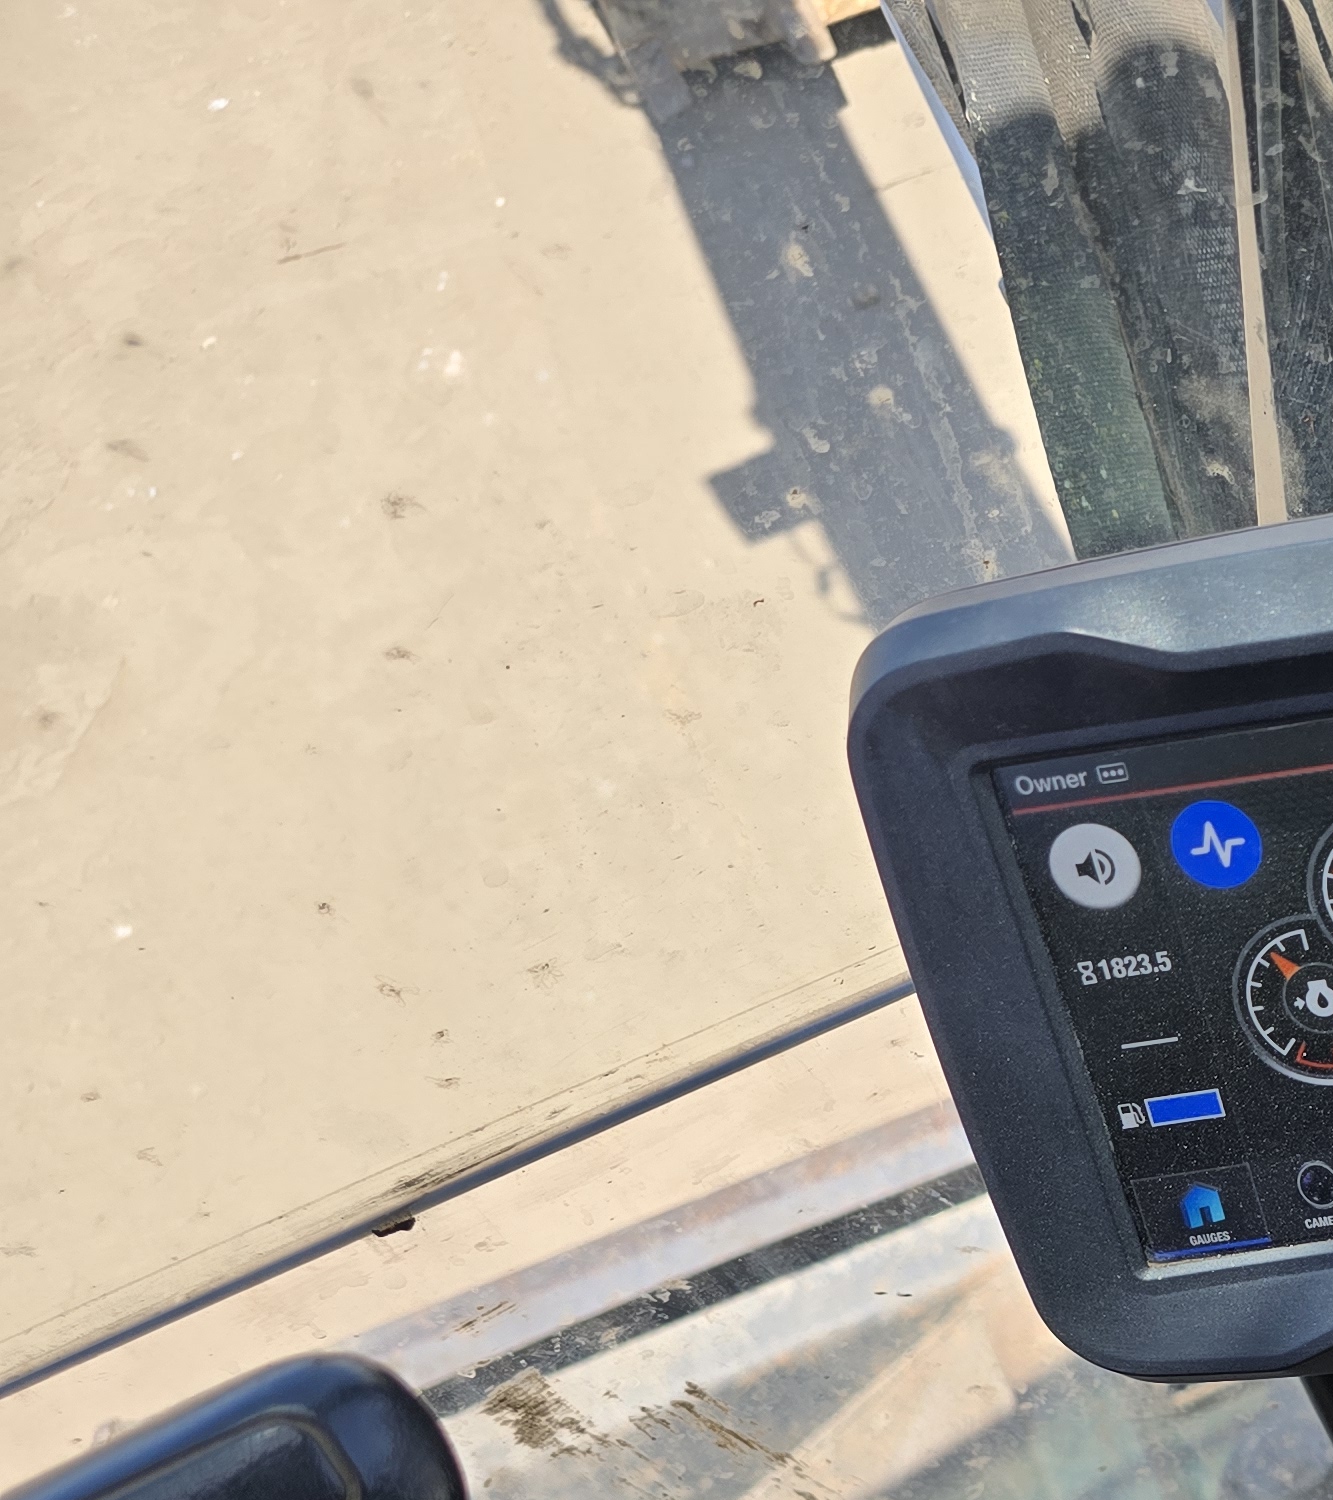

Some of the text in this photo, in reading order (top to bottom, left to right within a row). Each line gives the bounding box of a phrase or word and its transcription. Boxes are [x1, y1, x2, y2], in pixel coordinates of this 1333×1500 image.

[1014, 771, 1088, 796] Owner
[1096, 950, 1173, 980] 1823.5
[1188, 1230, 1232, 1247] GAUGES
